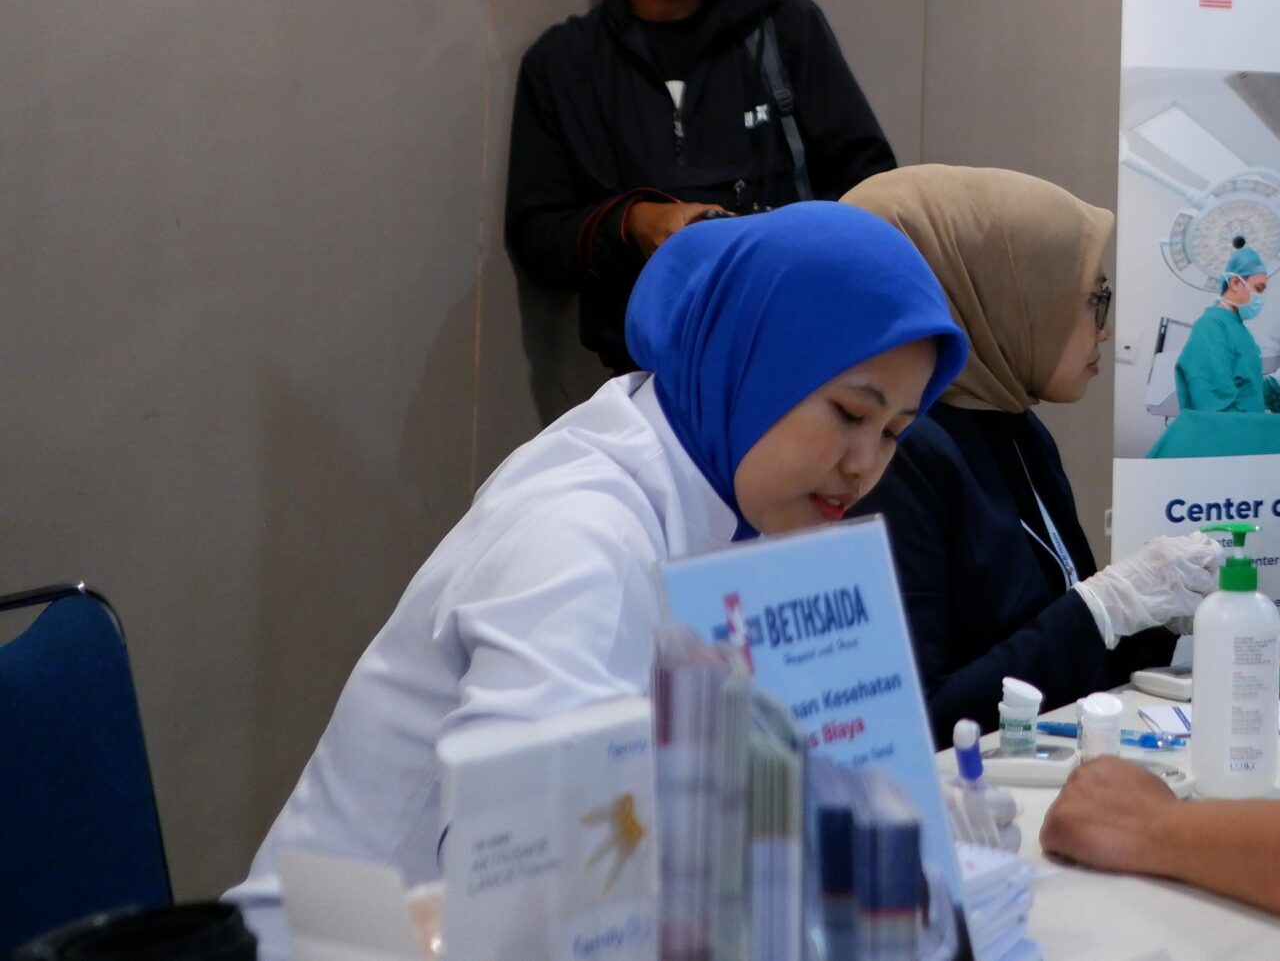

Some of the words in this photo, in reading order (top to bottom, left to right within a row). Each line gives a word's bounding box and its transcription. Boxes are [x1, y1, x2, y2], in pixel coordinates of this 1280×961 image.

[1165, 497, 1264, 523] Center
[1249, 555, 1280, 567] enter
[764, 583, 869, 647] BETHSAIDA
[821, 673, 903, 710] Kesehatan
[821, 716, 866, 743] Biaya
